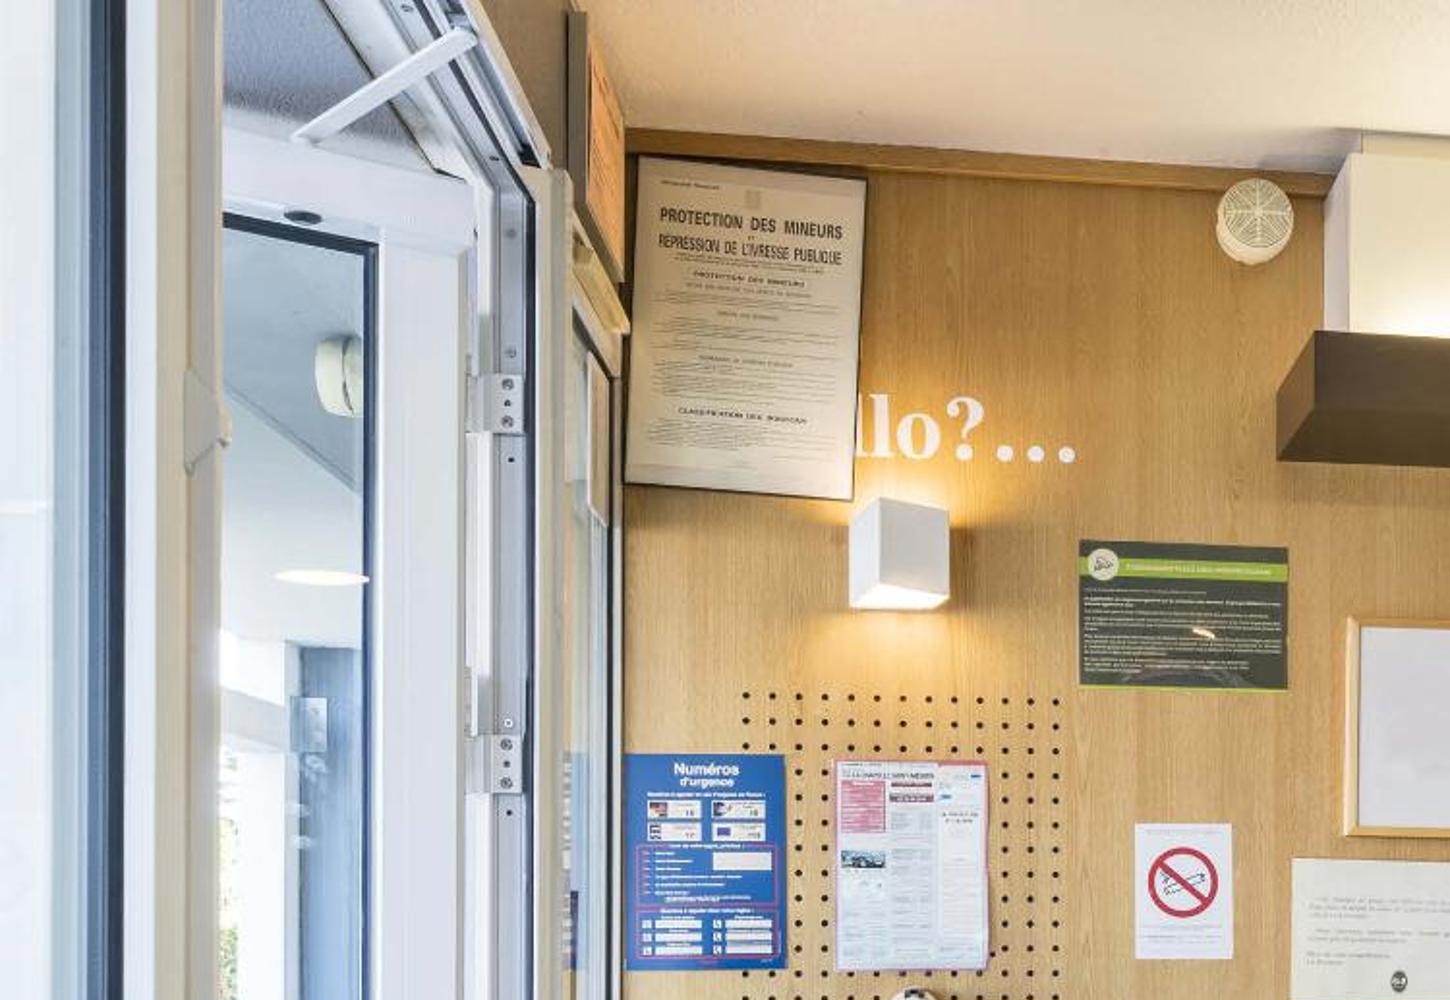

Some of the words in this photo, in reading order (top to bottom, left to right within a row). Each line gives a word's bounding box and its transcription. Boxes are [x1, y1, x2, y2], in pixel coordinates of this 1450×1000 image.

[660, 206, 743, 230] PROTECTION
[751, 217, 776, 233] DES
[784, 220, 843, 241] MINEURS
[724, 241, 737, 256] DE
[793, 248, 843, 266] PUBLIQUE
[673, 762, 740, 776] Numéros
[680, 777, 735, 789] d'urgence
